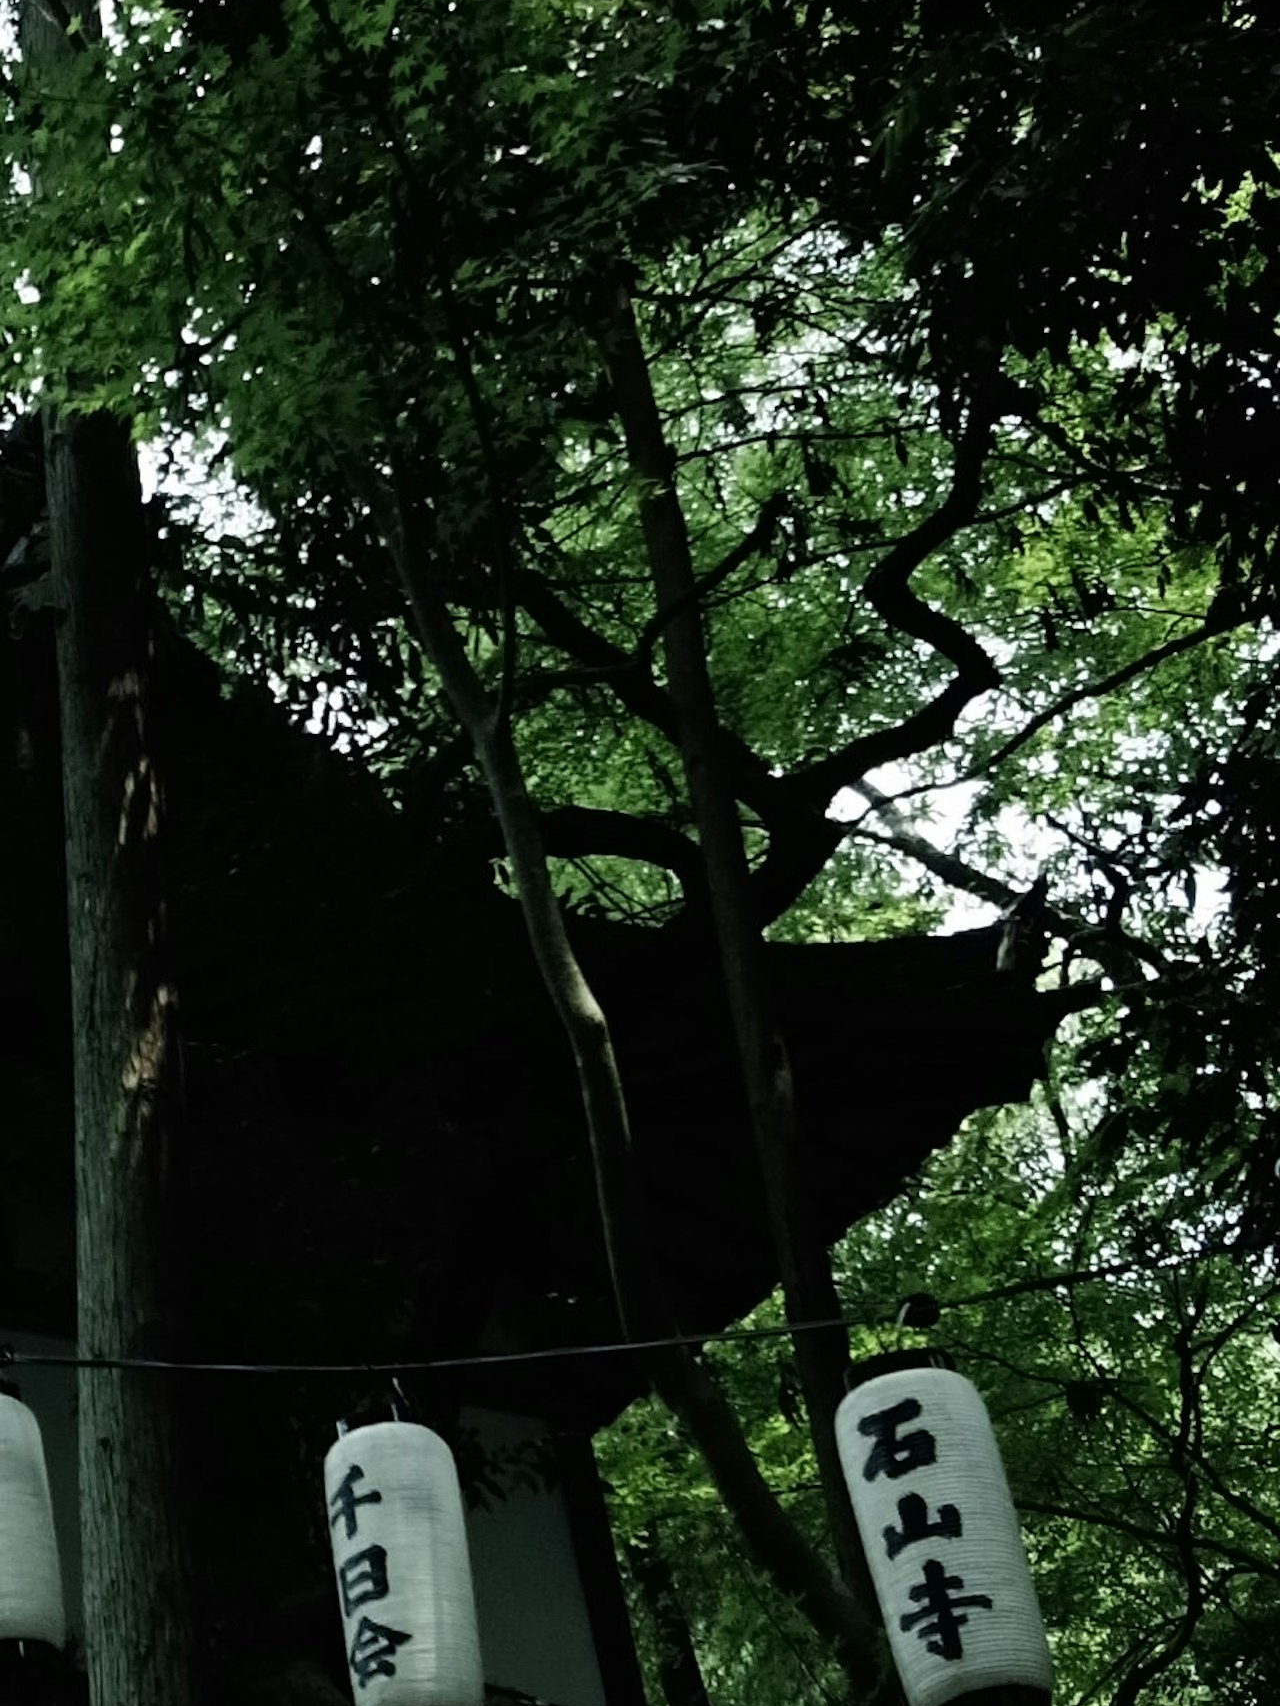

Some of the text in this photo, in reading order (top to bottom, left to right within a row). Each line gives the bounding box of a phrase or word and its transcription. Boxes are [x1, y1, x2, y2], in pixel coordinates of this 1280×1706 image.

[331, 1463, 413, 1688] 千日会
[857, 1397, 993, 1661] 石山寺
